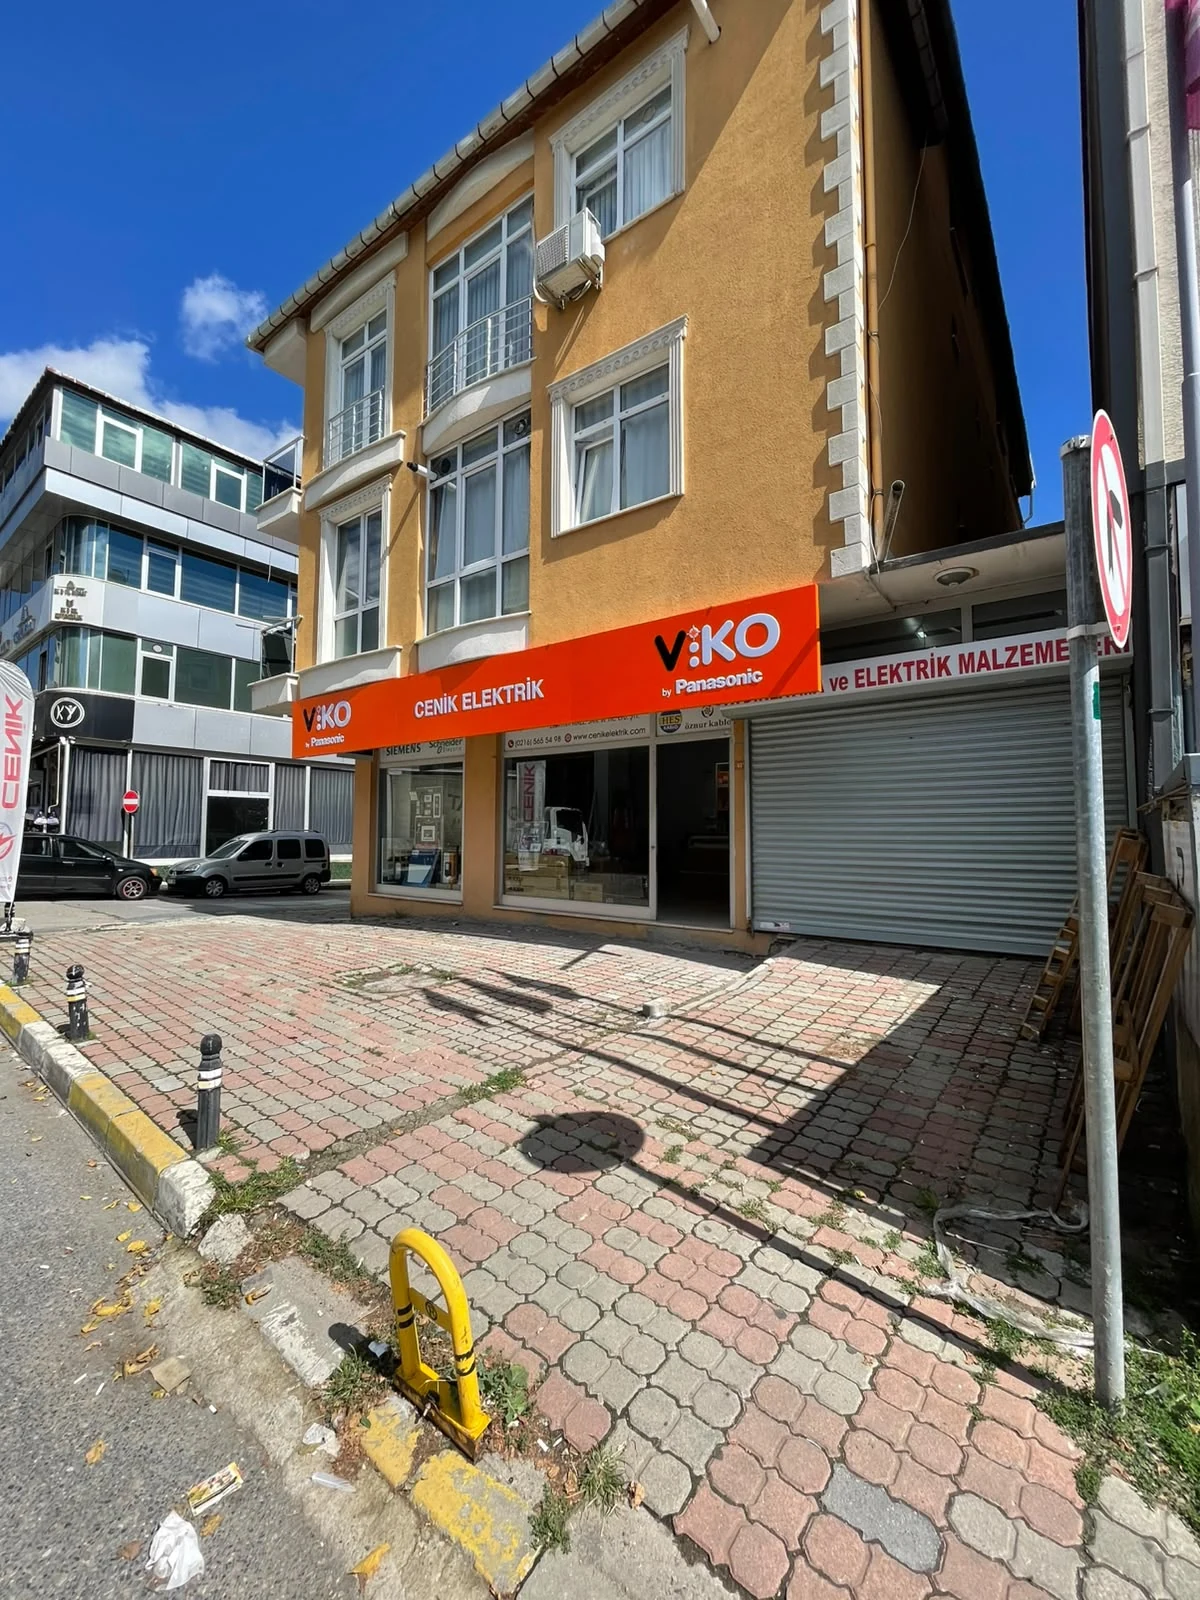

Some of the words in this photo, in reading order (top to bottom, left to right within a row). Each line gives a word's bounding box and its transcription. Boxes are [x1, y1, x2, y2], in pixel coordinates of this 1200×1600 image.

[829, 676, 848, 691] ve
[854, 652, 953, 689] ELEKTRİK
[959, 635, 1130, 674] MALZEMER
[661, 688, 672, 698] by
[675, 668, 763, 695] Panasonic
[414, 692, 458, 719] CENİK
[462, 677, 545, 711] ELEKTRİK
[662, 715, 680, 725] HES
[685, 721, 708, 729] öznur
[311, 733, 345, 747] Panasonic
[572, 727, 646, 741] www.cenikelektrik.com
[386, 743, 421, 756] SIEMENS
